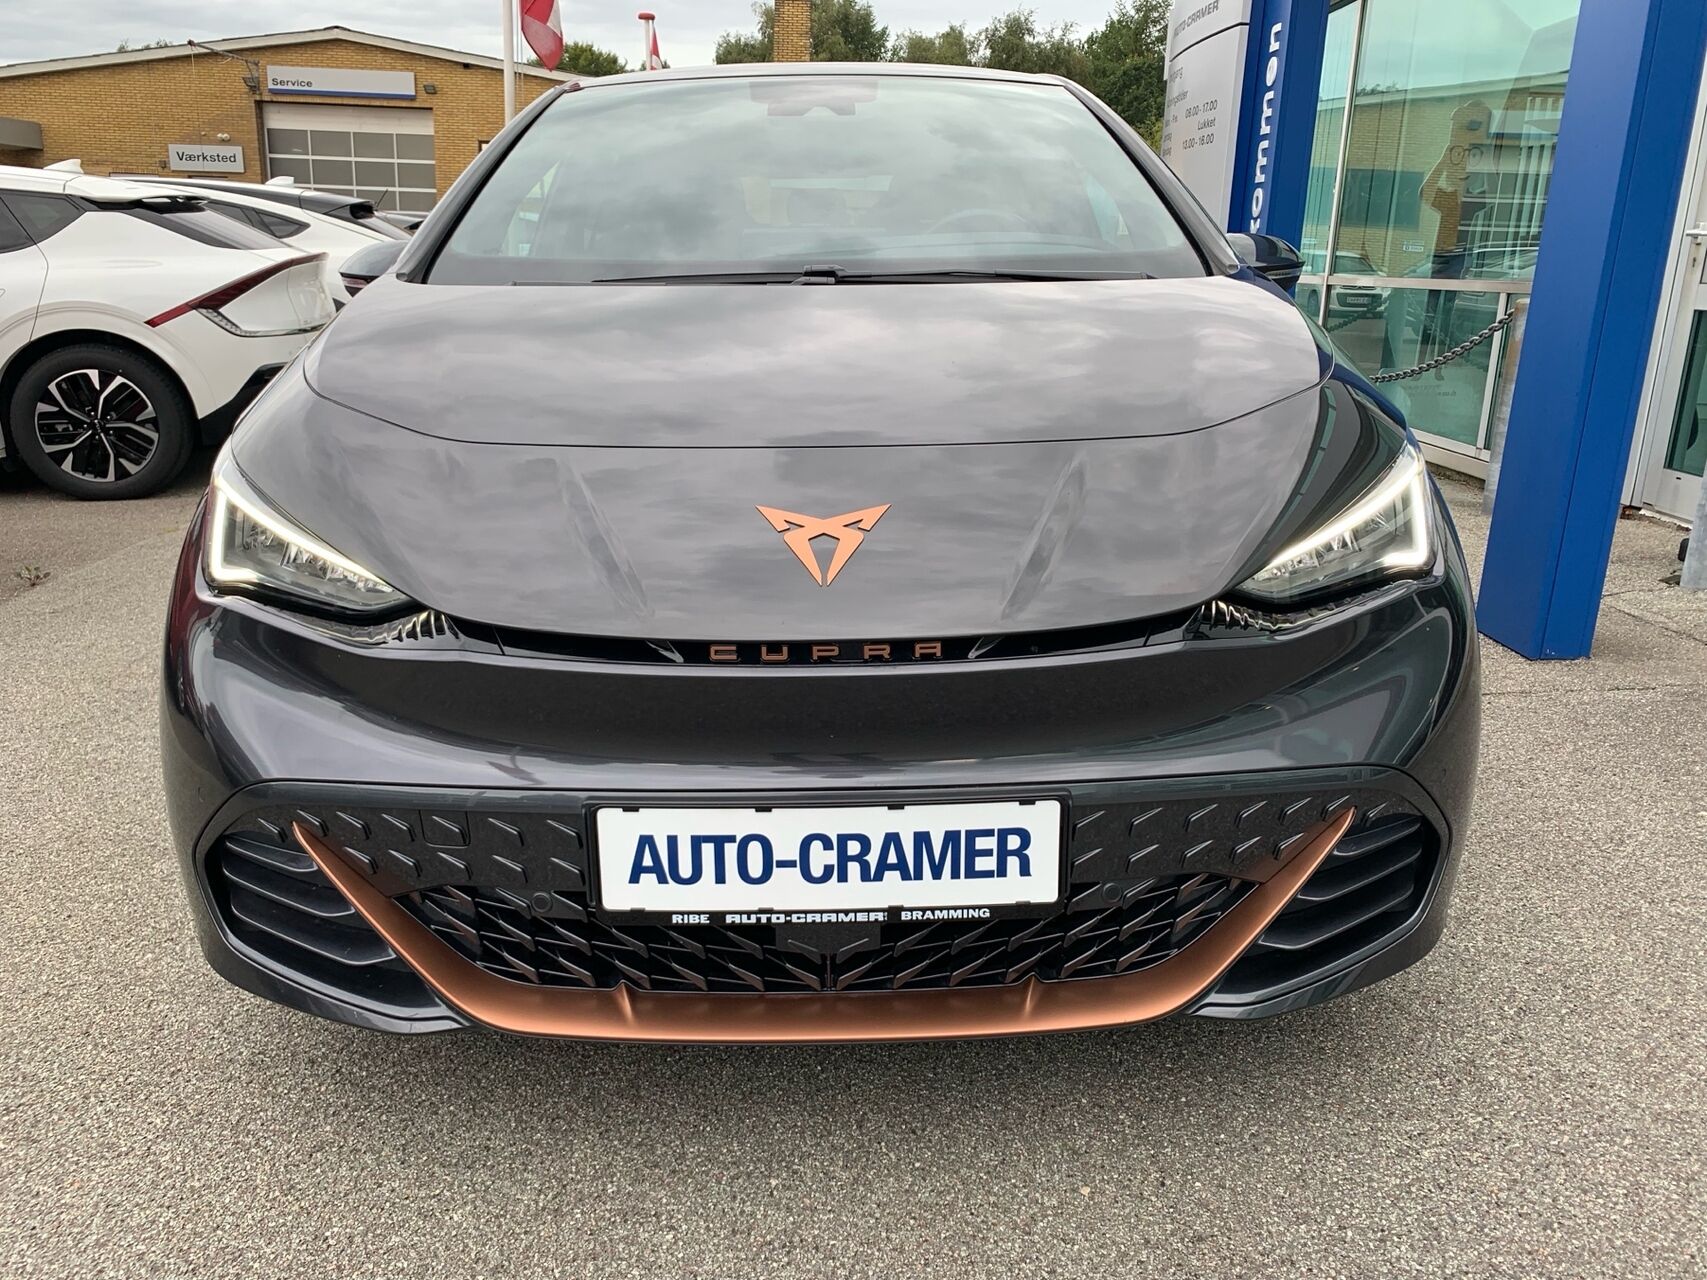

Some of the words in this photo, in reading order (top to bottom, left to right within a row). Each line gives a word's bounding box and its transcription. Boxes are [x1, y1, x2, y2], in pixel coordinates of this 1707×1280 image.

[271, 77, 313, 88] Service
[1198, 117, 1216, 131] Lukket
[176, 151, 237, 163] Værksted
[709, 641, 942, 661] CUPRA
[627, 827, 1033, 886] AUTO-CRAMER
[672, 914, 710, 924] RIBE
[901, 908, 991, 921] BRAMMING
